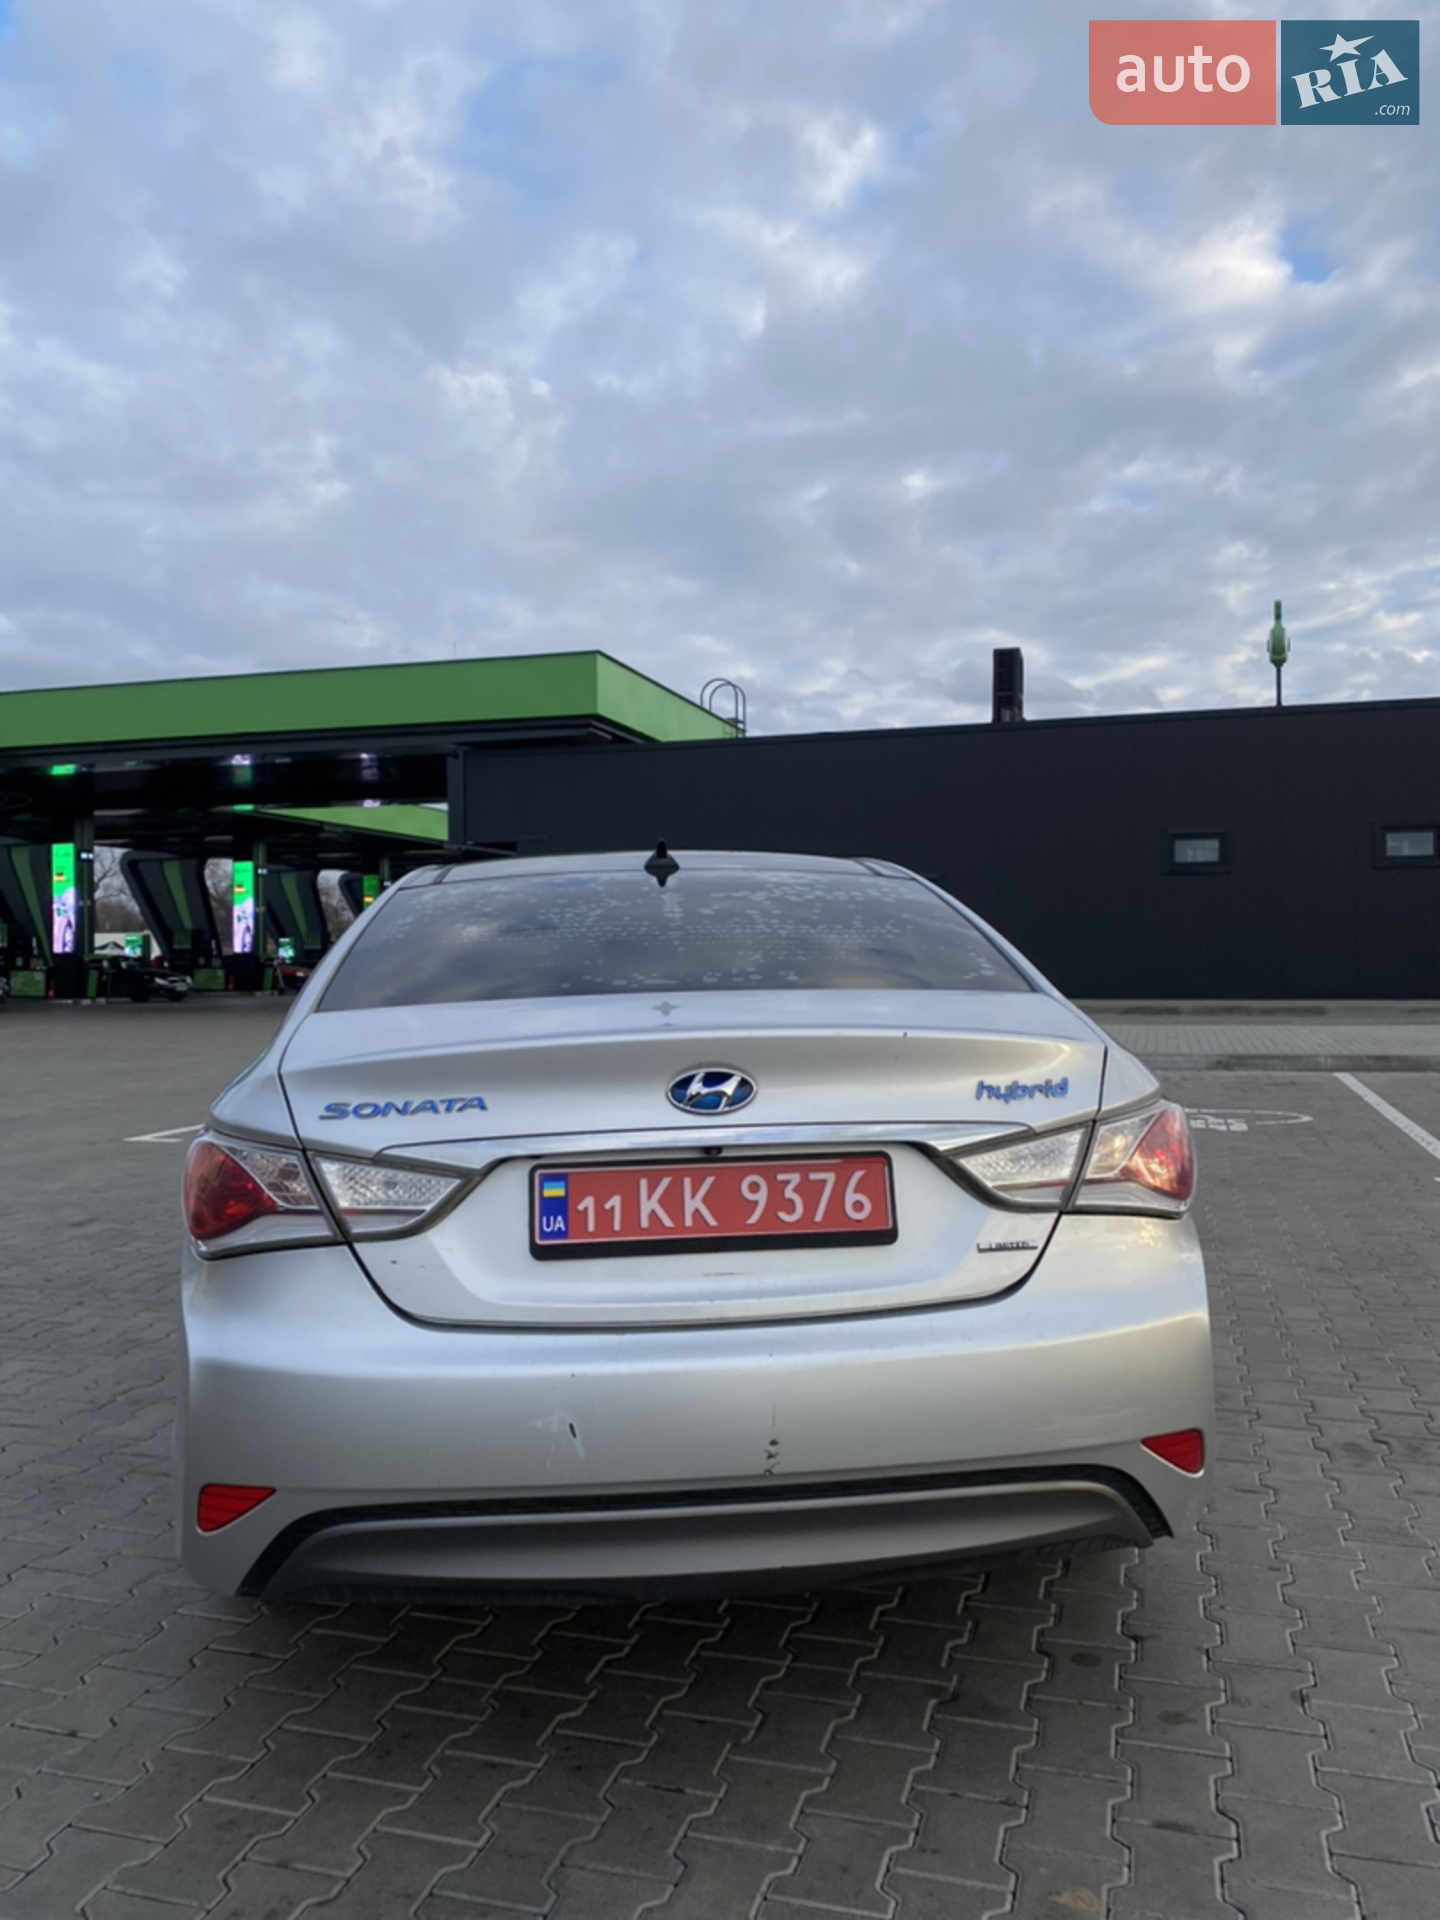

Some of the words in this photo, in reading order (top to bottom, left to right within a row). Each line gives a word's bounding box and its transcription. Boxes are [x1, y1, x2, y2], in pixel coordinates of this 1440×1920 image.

[976, 1076, 1069, 1105] hybrid
[318, 1096, 489, 1121] SONATA
[740, 1169, 873, 1225] 9376
[542, 1215, 566, 1232] UA
